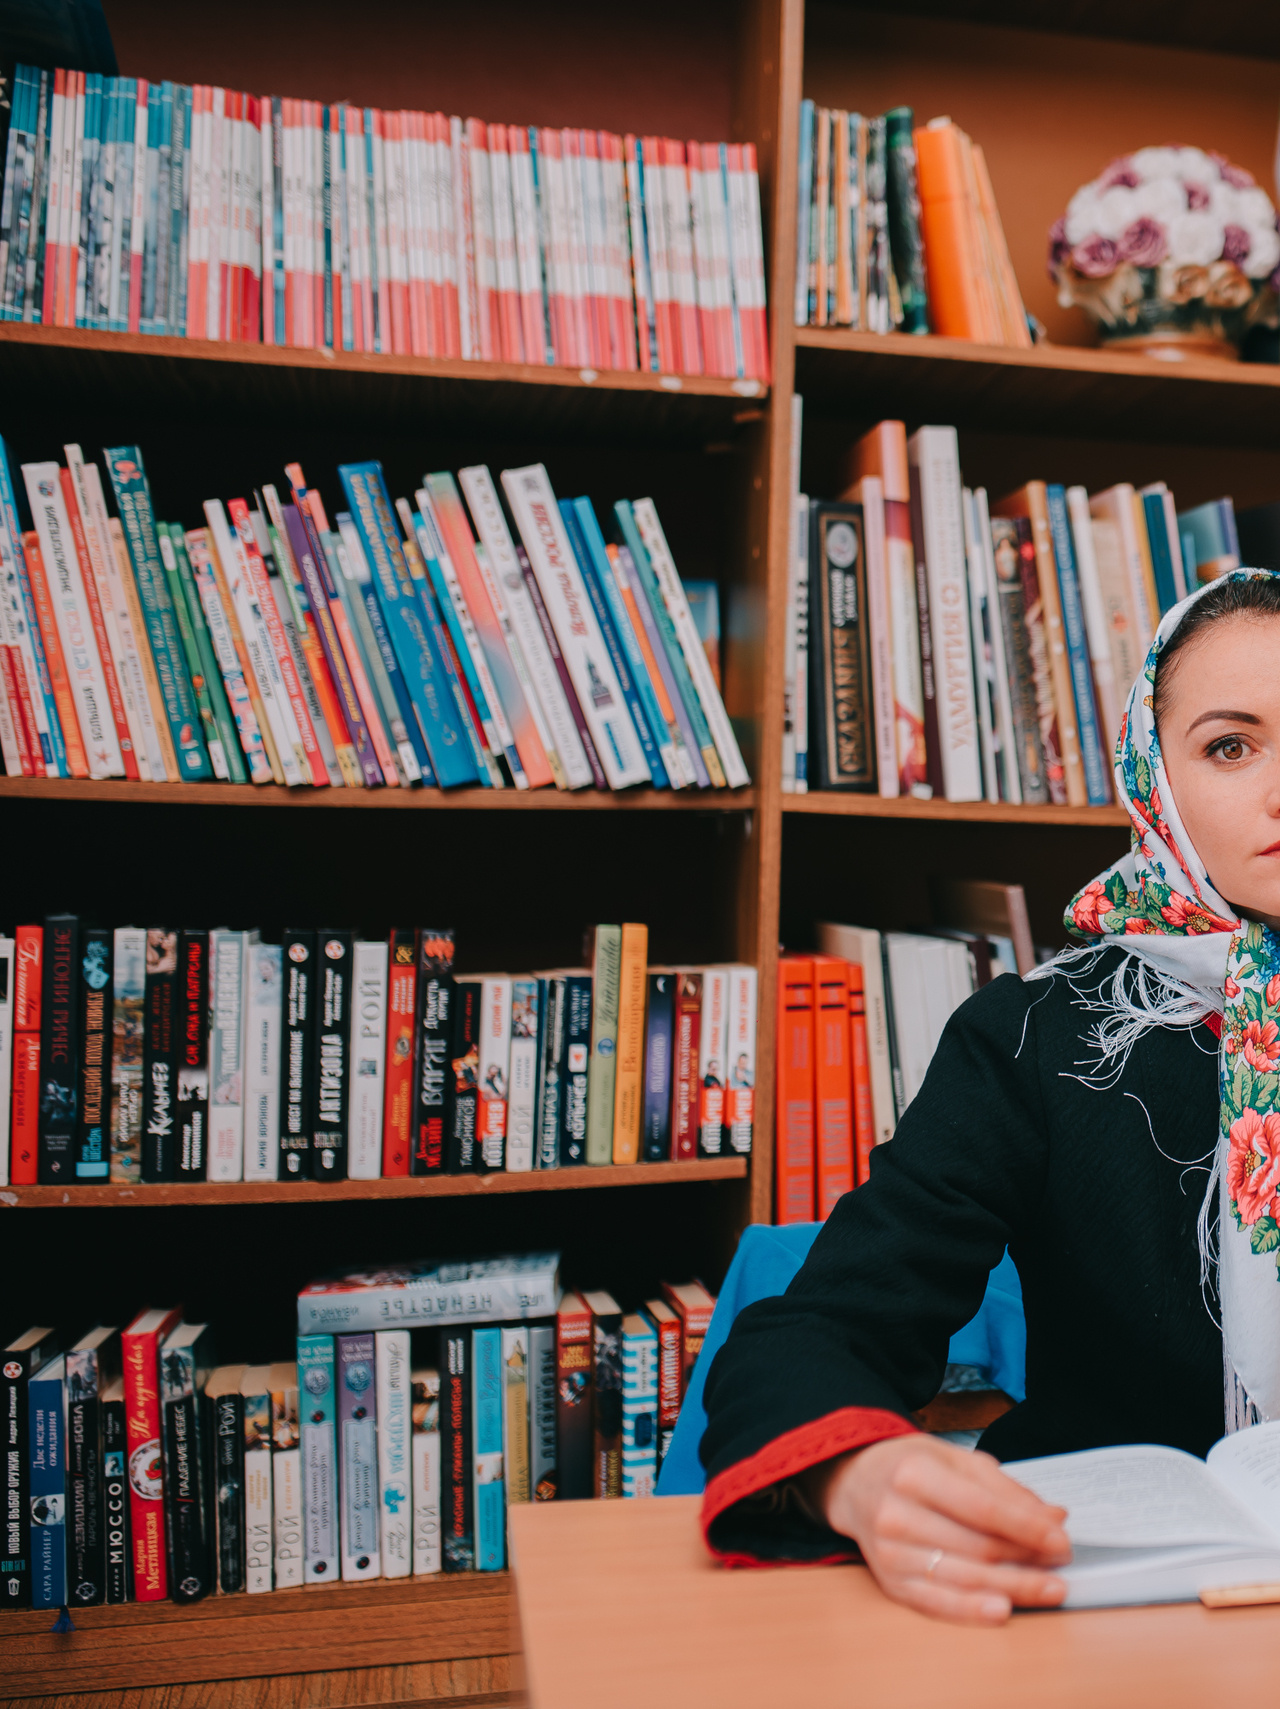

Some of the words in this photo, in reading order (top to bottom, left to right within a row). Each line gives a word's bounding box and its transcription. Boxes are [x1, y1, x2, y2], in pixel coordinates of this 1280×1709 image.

[44, 504, 72, 594] ЭНЦИКЛОПЕДИЯ
[832, 627, 864, 772] СКАЗАНИЯ
[52, 927, 71, 1001] ЭНТОНИ
[187, 942, 201, 1000] ПАТРОНЫ
[217, 941, 239, 1030] ВЕДЕНСКАЯ
[357, 979, 382, 1039] РОЙ
[51, 1010, 69, 1064] РИЧЕС
[86, 1033, 104, 1065] ПОХОД
[289, 1030, 303, 1088] ВЫЖИВАНИЕ
[82, 1067, 103, 1124] ПОСЛЕДНИЙ
[289, 1089, 302, 1103] НА
[318, 1033, 343, 1123] АНТИЗОНА
[259, 1094, 269, 1138] ВОРОНОВА
[288, 1105, 301, 1133] КВЕСТ
[573, 1074, 587, 1140] КОЛЫЧЕВ
[258, 1140, 268, 1170] МАРИЯ
[380, 1292, 493, 1317] НЕНАСТЬЕ
[9, 1386, 18, 1418] Левицкий
[73, 1404, 84, 1444] БОБЛ
[129, 1409, 152, 1438] На
[174, 1404, 187, 1442] НЕБЕС
[451, 1377, 463, 1429] ПОЛЕСЬЯ
[541, 1349, 555, 1459] ЛИТВИНОВЫ
[9, 1420, 18, 1444] Андрей
[34, 1409, 45, 1446] недели
[48, 1410, 58, 1467] ожидания
[8, 1450, 20, 1487] ОРУЖИЯ
[33, 1449, 47, 1471] Две
[176, 1443, 191, 1497] ПАДЕНИЕ
[8, 1489, 20, 1520] ВЫБОР
[72, 1479, 86, 1553] ЛЕВИЦКИЙ
[107, 1482, 124, 1564] МЮССО
[453, 1486, 464, 1538] КРАСНЫЕ
[7, 1522, 20, 1554] НОВЫЙ
[87, 1509, 97, 1546] ПАРОЛЬ
[42, 1529, 52, 1571] РАЙНЕР
[135, 1539, 145, 1574] Мария
[144, 1511, 160, 1590] Метлицкая
[43, 1574, 52, 1601] САРА
